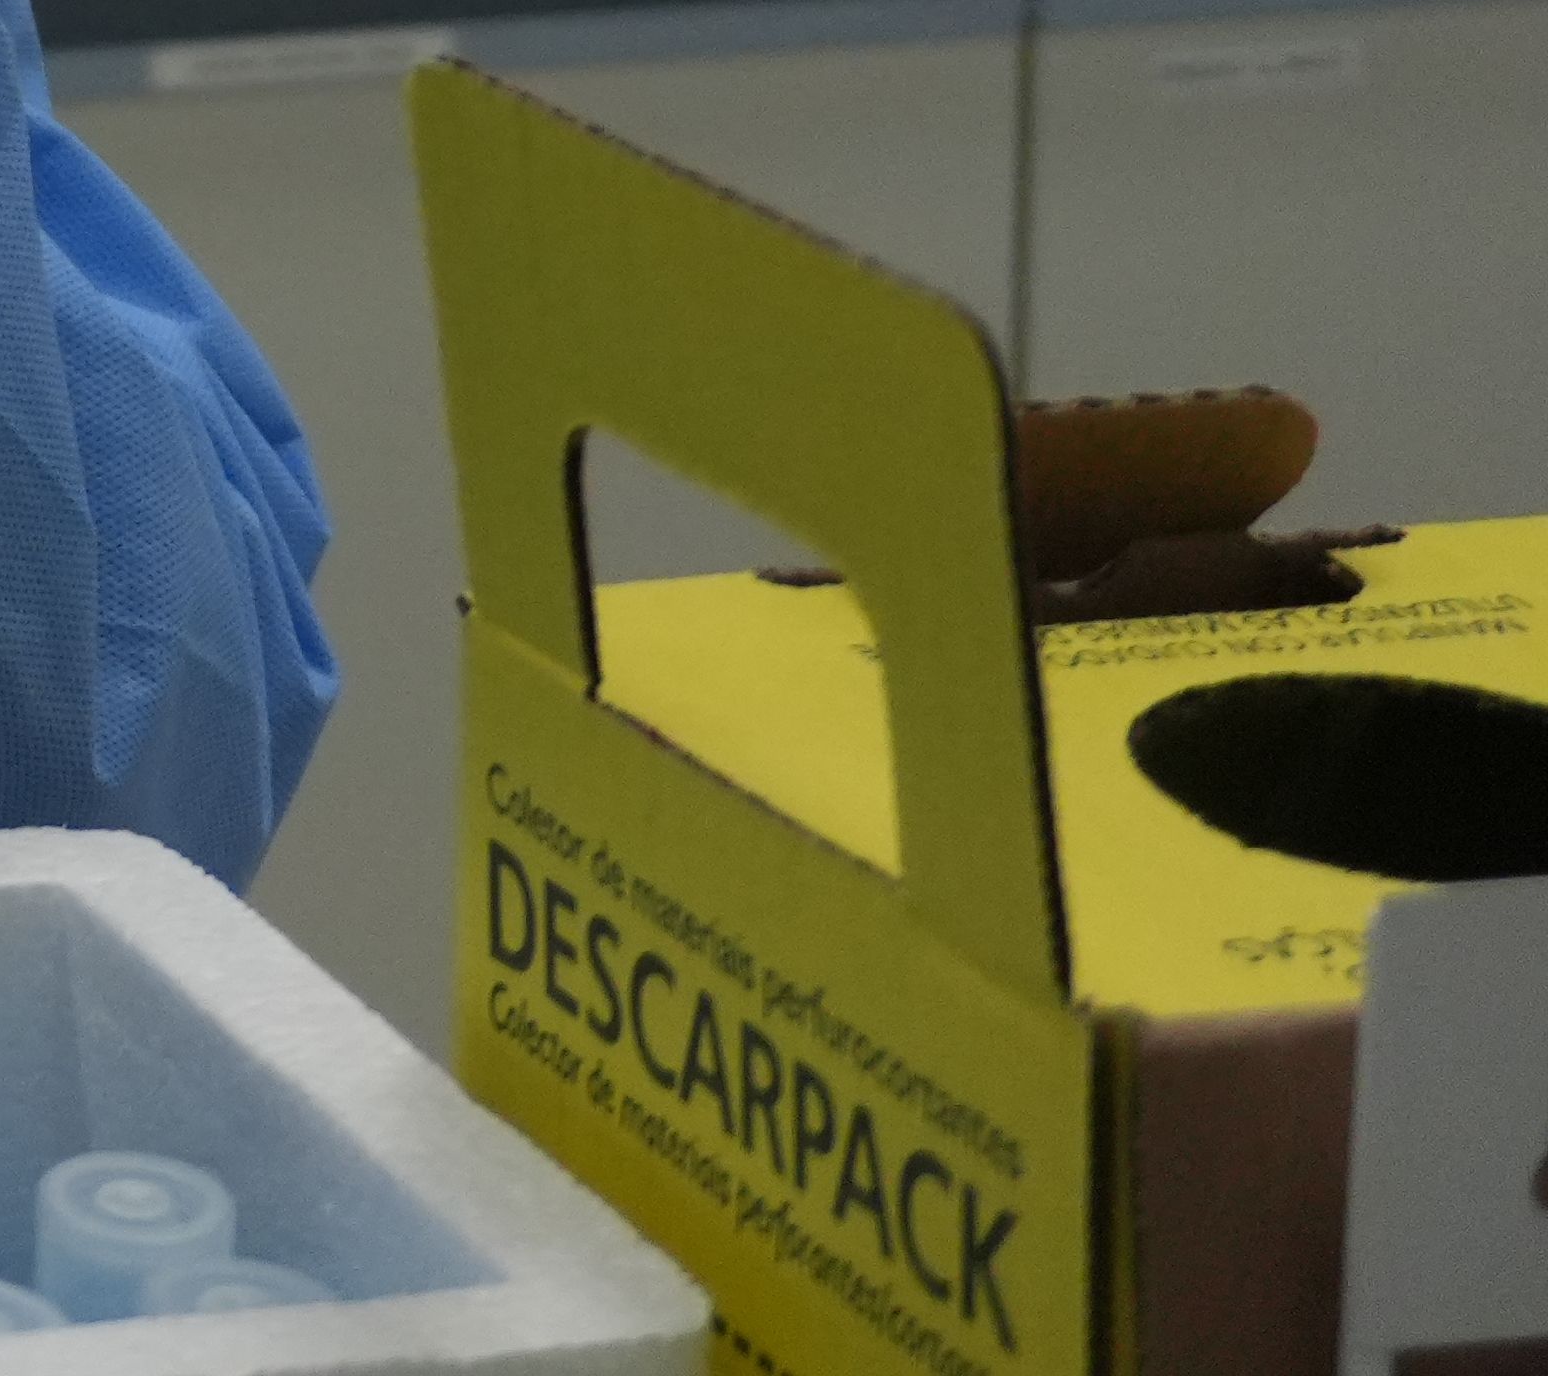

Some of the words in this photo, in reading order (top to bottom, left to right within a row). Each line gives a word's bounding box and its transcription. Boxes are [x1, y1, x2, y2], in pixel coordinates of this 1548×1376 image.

[590, 840, 627, 900] de
[630, 876, 755, 991] materiais
[488, 836, 1019, 1354] DESCARPACK
[586, 1059, 617, 1115] de
